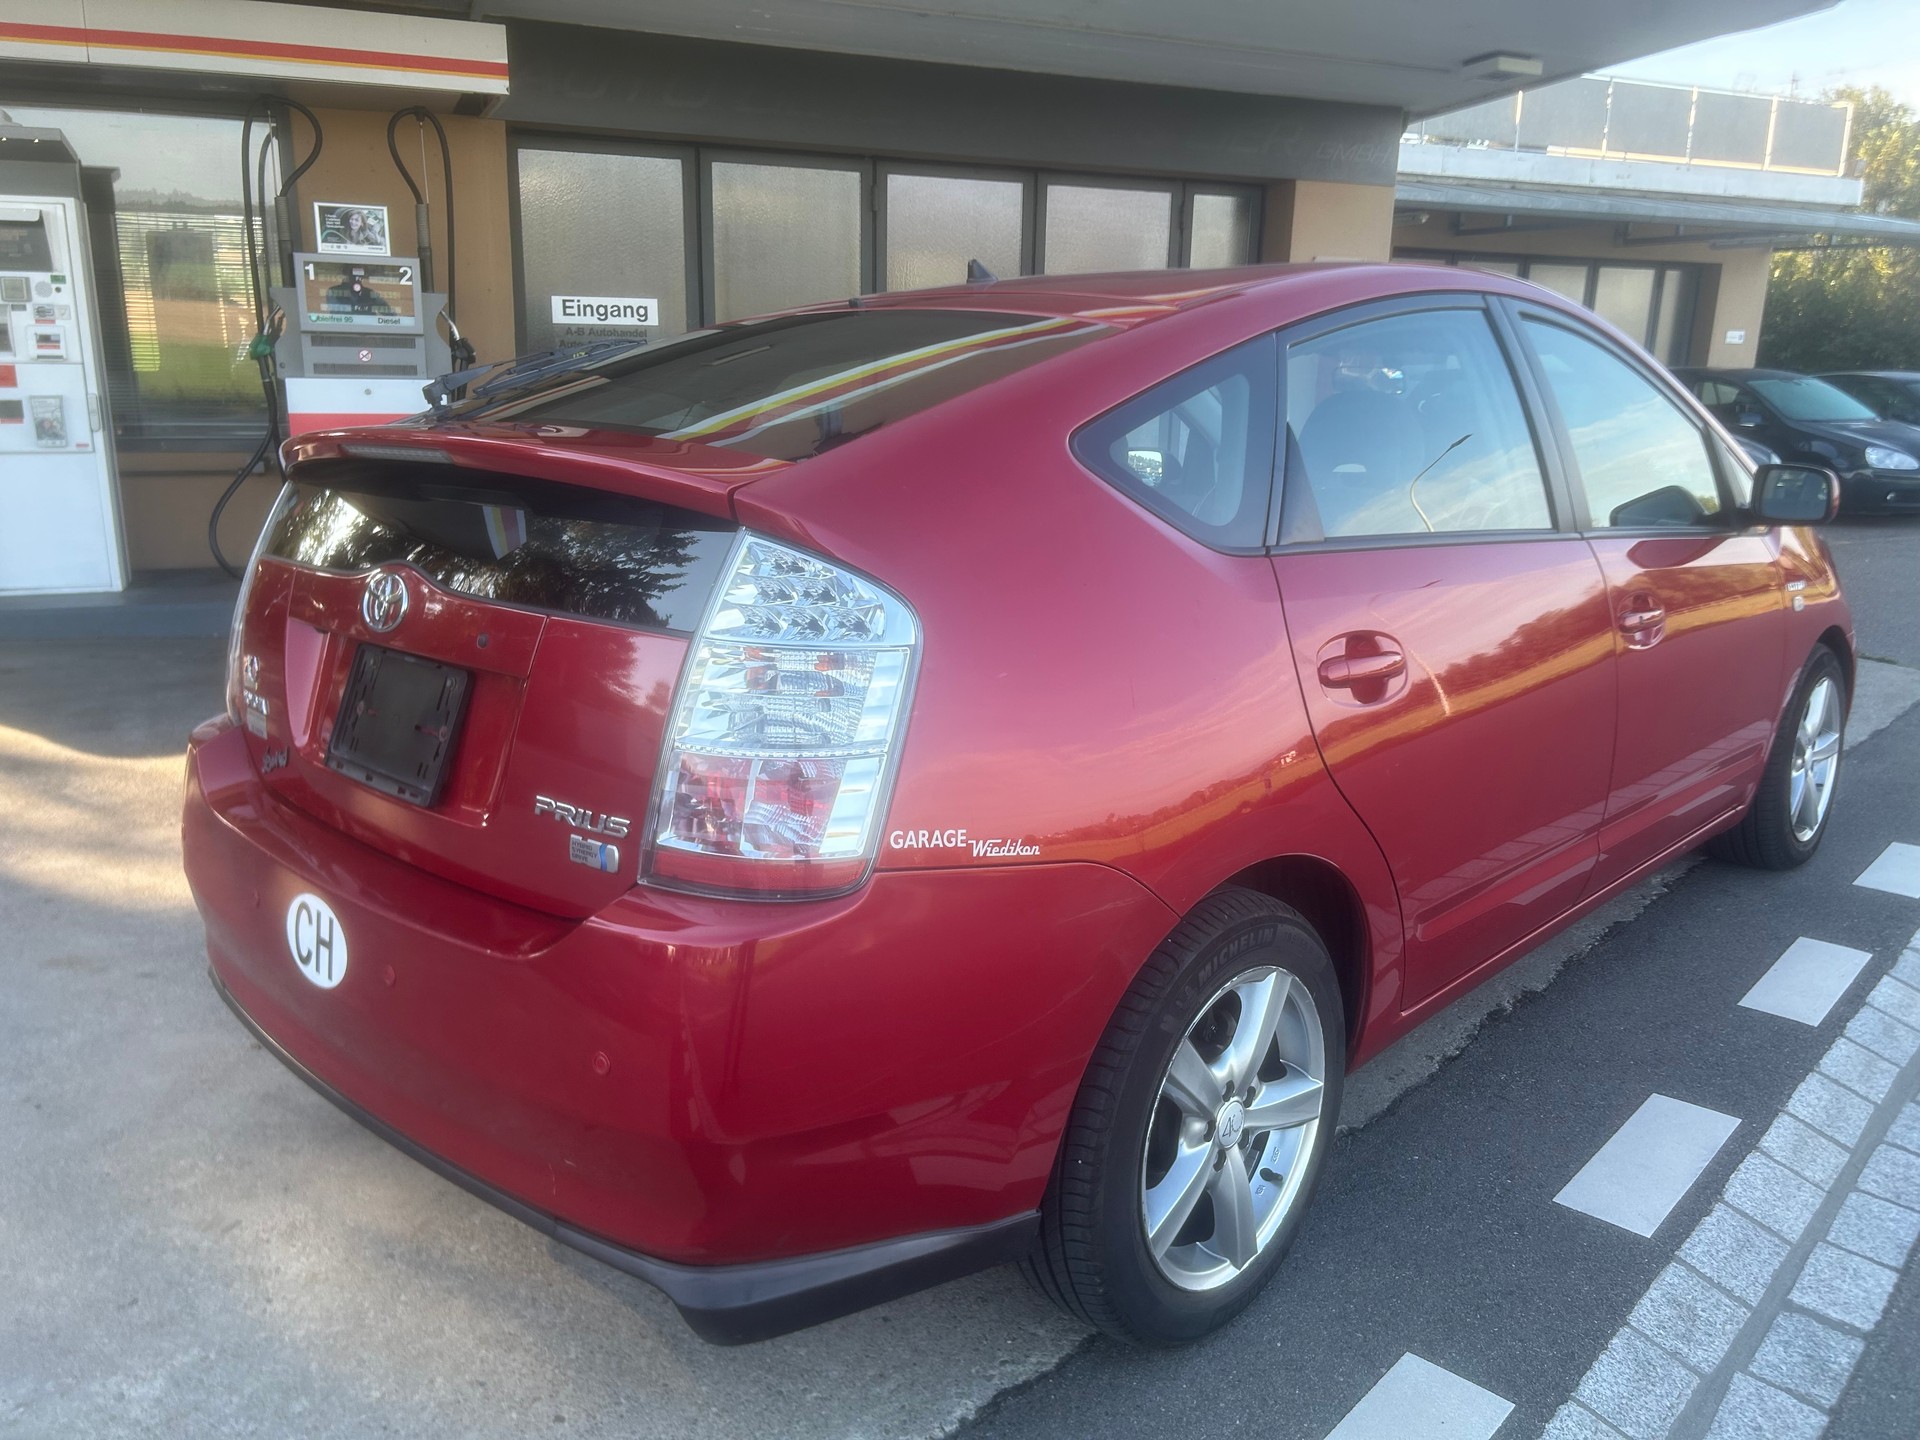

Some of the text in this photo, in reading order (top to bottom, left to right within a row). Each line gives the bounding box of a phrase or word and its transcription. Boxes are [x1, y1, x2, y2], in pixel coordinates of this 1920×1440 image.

[304, 263, 315, 281] 1
[399, 266, 413, 286] 2
[377, 317, 401, 325] Diesel
[562, 299, 649, 323] Eingang
[588, 327, 648, 338] Autohandel
[535, 795, 630, 838] PRIUS
[890, 829, 1041, 857] GARAGE Wiedikon
[294, 900, 335, 982] CH
[1199, 927, 1275, 987] MICHELIN
